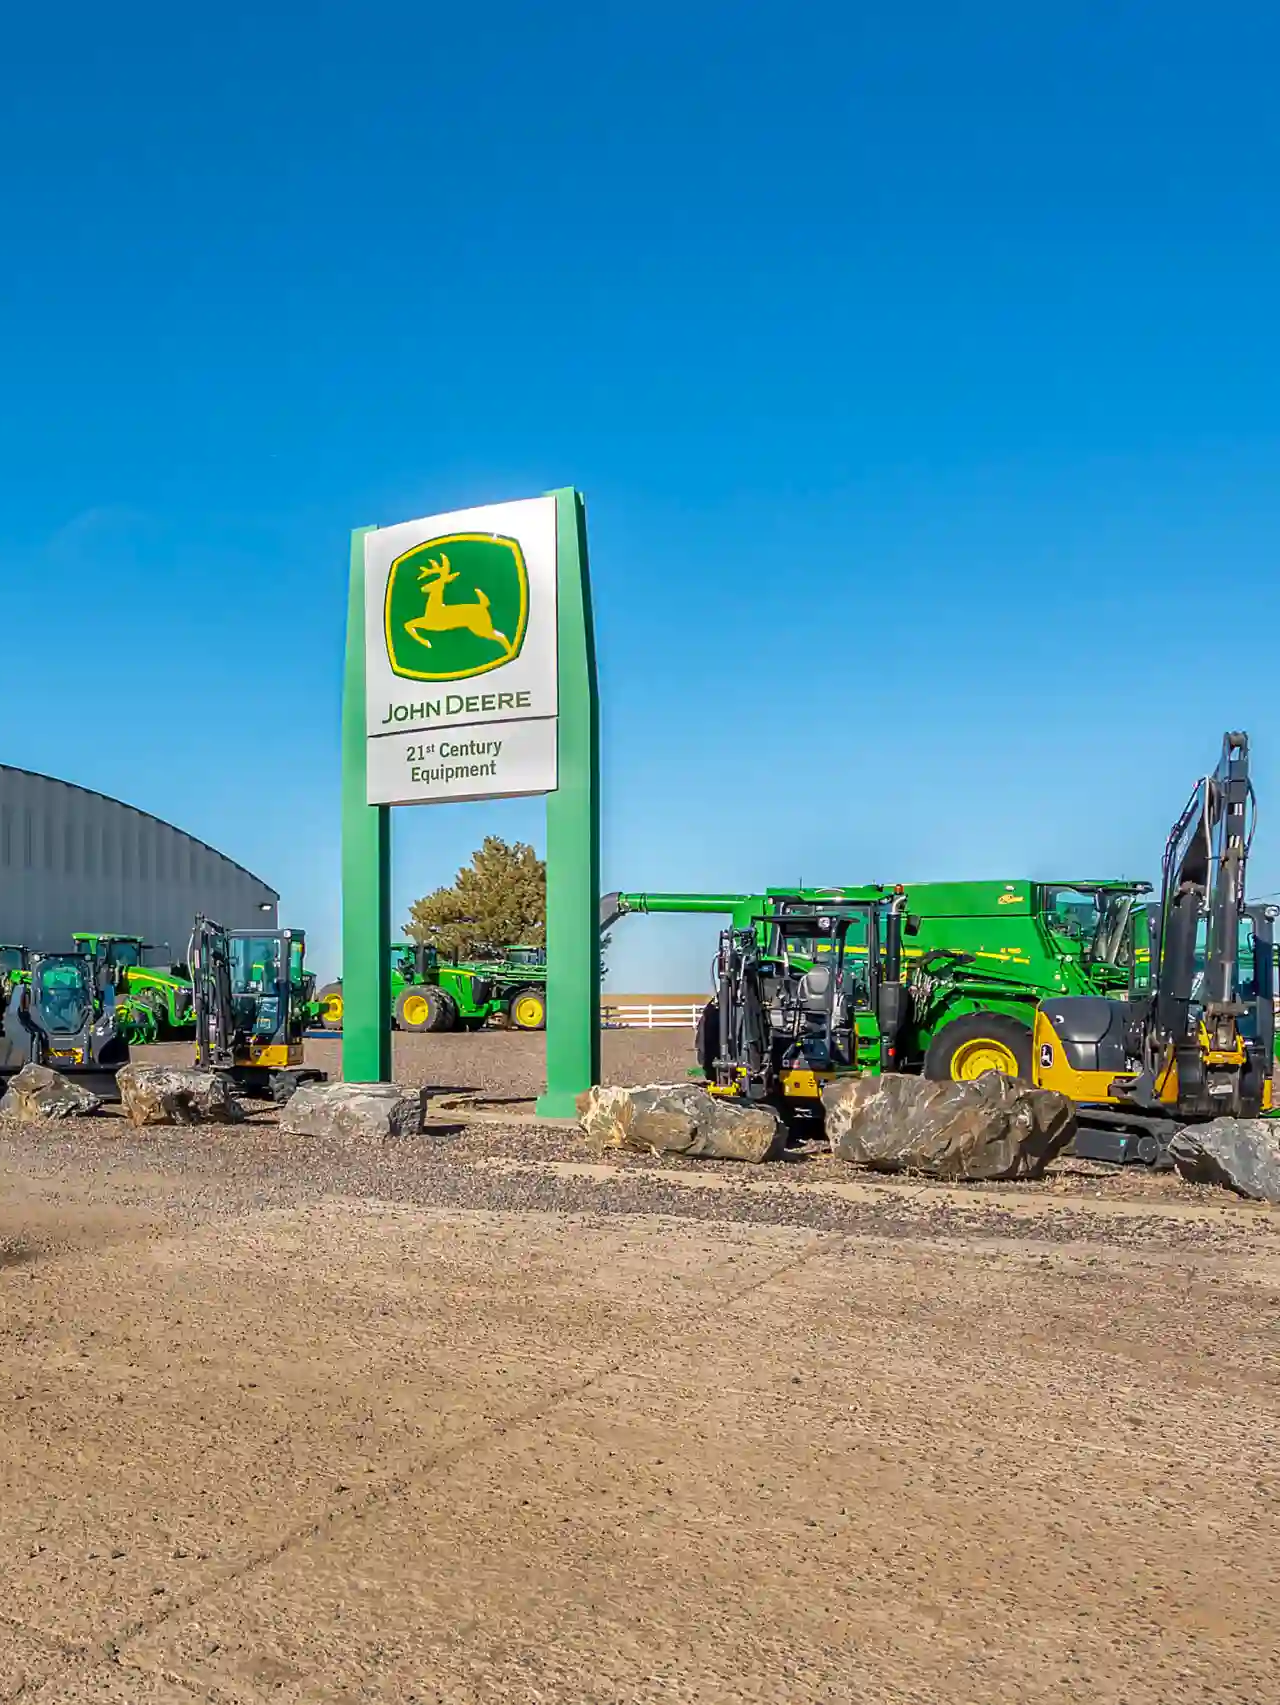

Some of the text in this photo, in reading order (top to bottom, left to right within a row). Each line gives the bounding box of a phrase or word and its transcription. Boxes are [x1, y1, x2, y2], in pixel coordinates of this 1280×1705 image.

[382, 691, 531, 724] JOHN DEERE
[406, 740, 502, 762] 21st Century
[411, 760, 496, 784] Equipment
